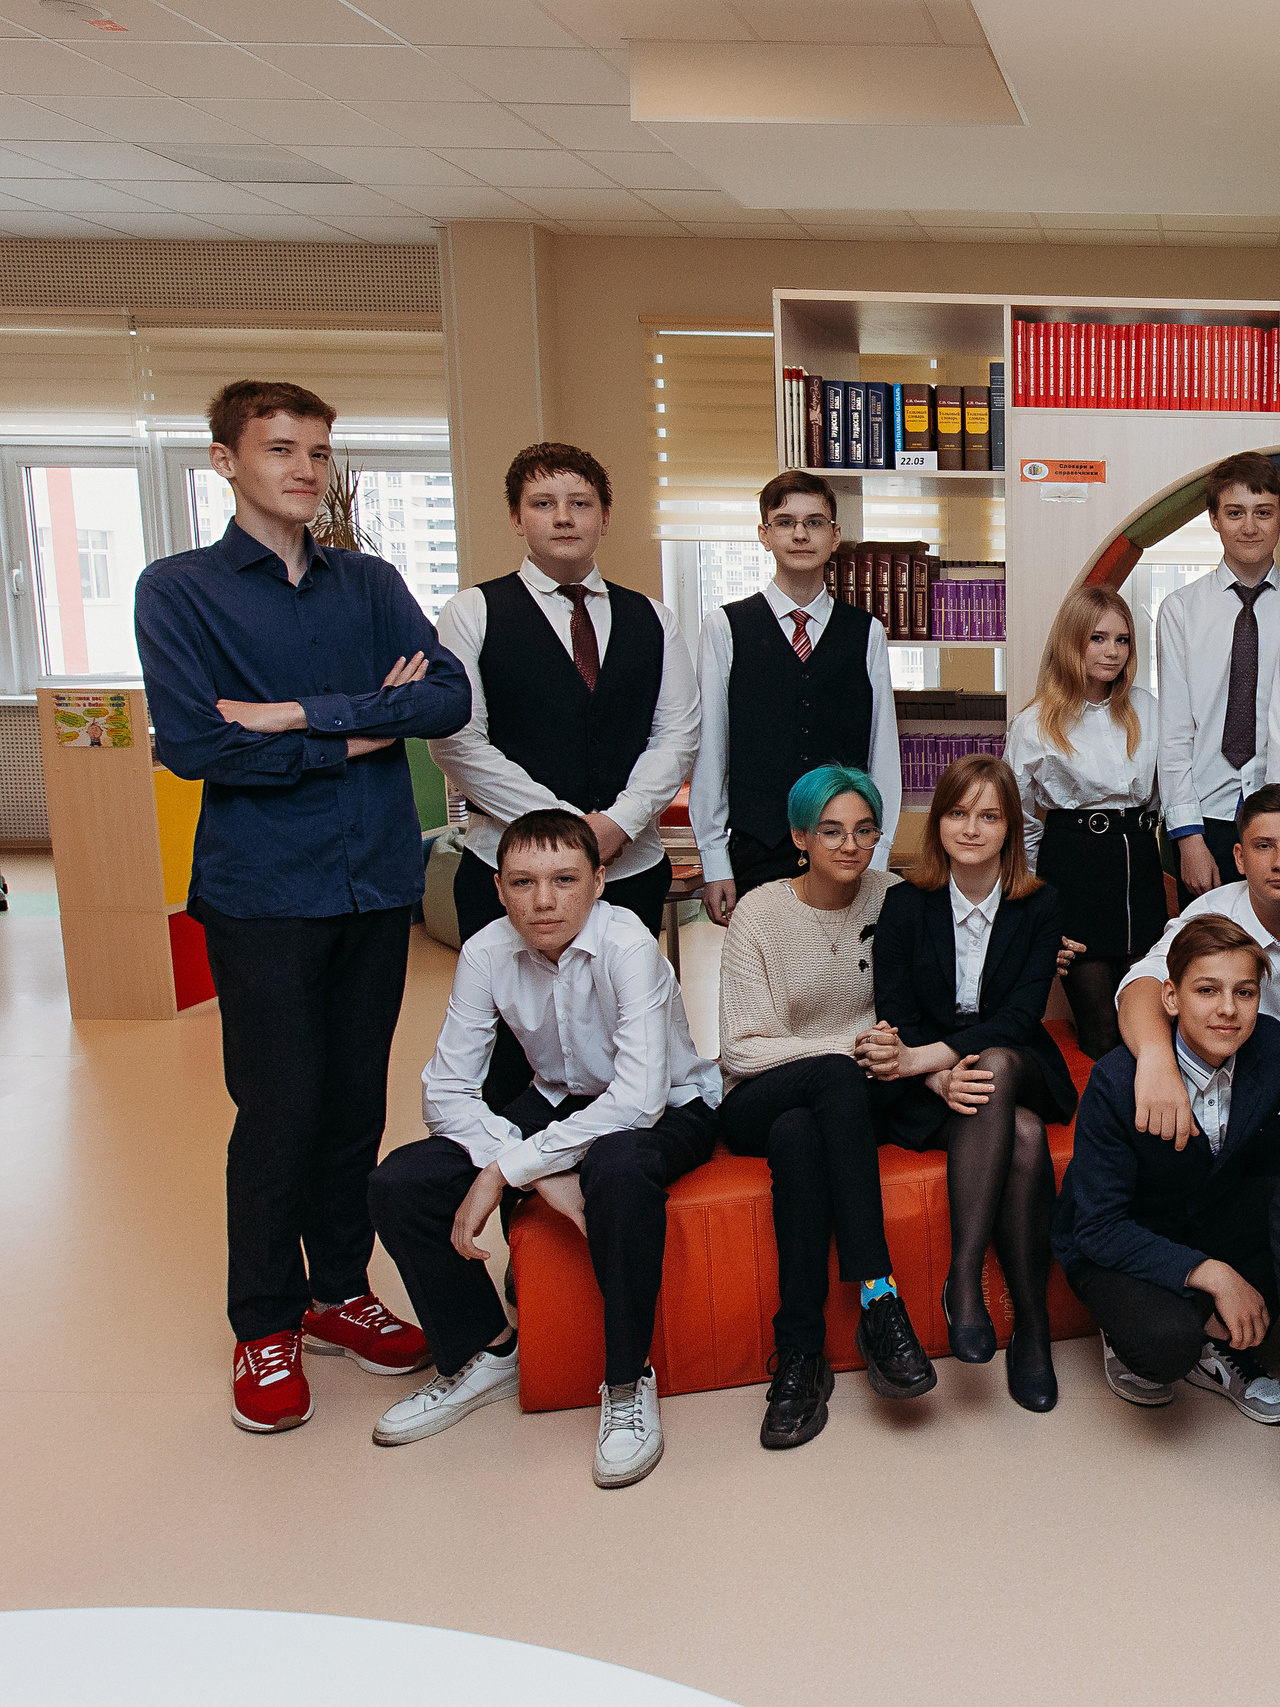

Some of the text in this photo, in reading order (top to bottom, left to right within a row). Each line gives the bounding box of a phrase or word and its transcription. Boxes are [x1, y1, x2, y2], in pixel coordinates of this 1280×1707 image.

[830, 411, 839, 438] ТРУДНОСТЕЙ
[852, 412, 860, 439] ТРУДНОСТЕЙ
[900, 457, 925, 466] 22.03
